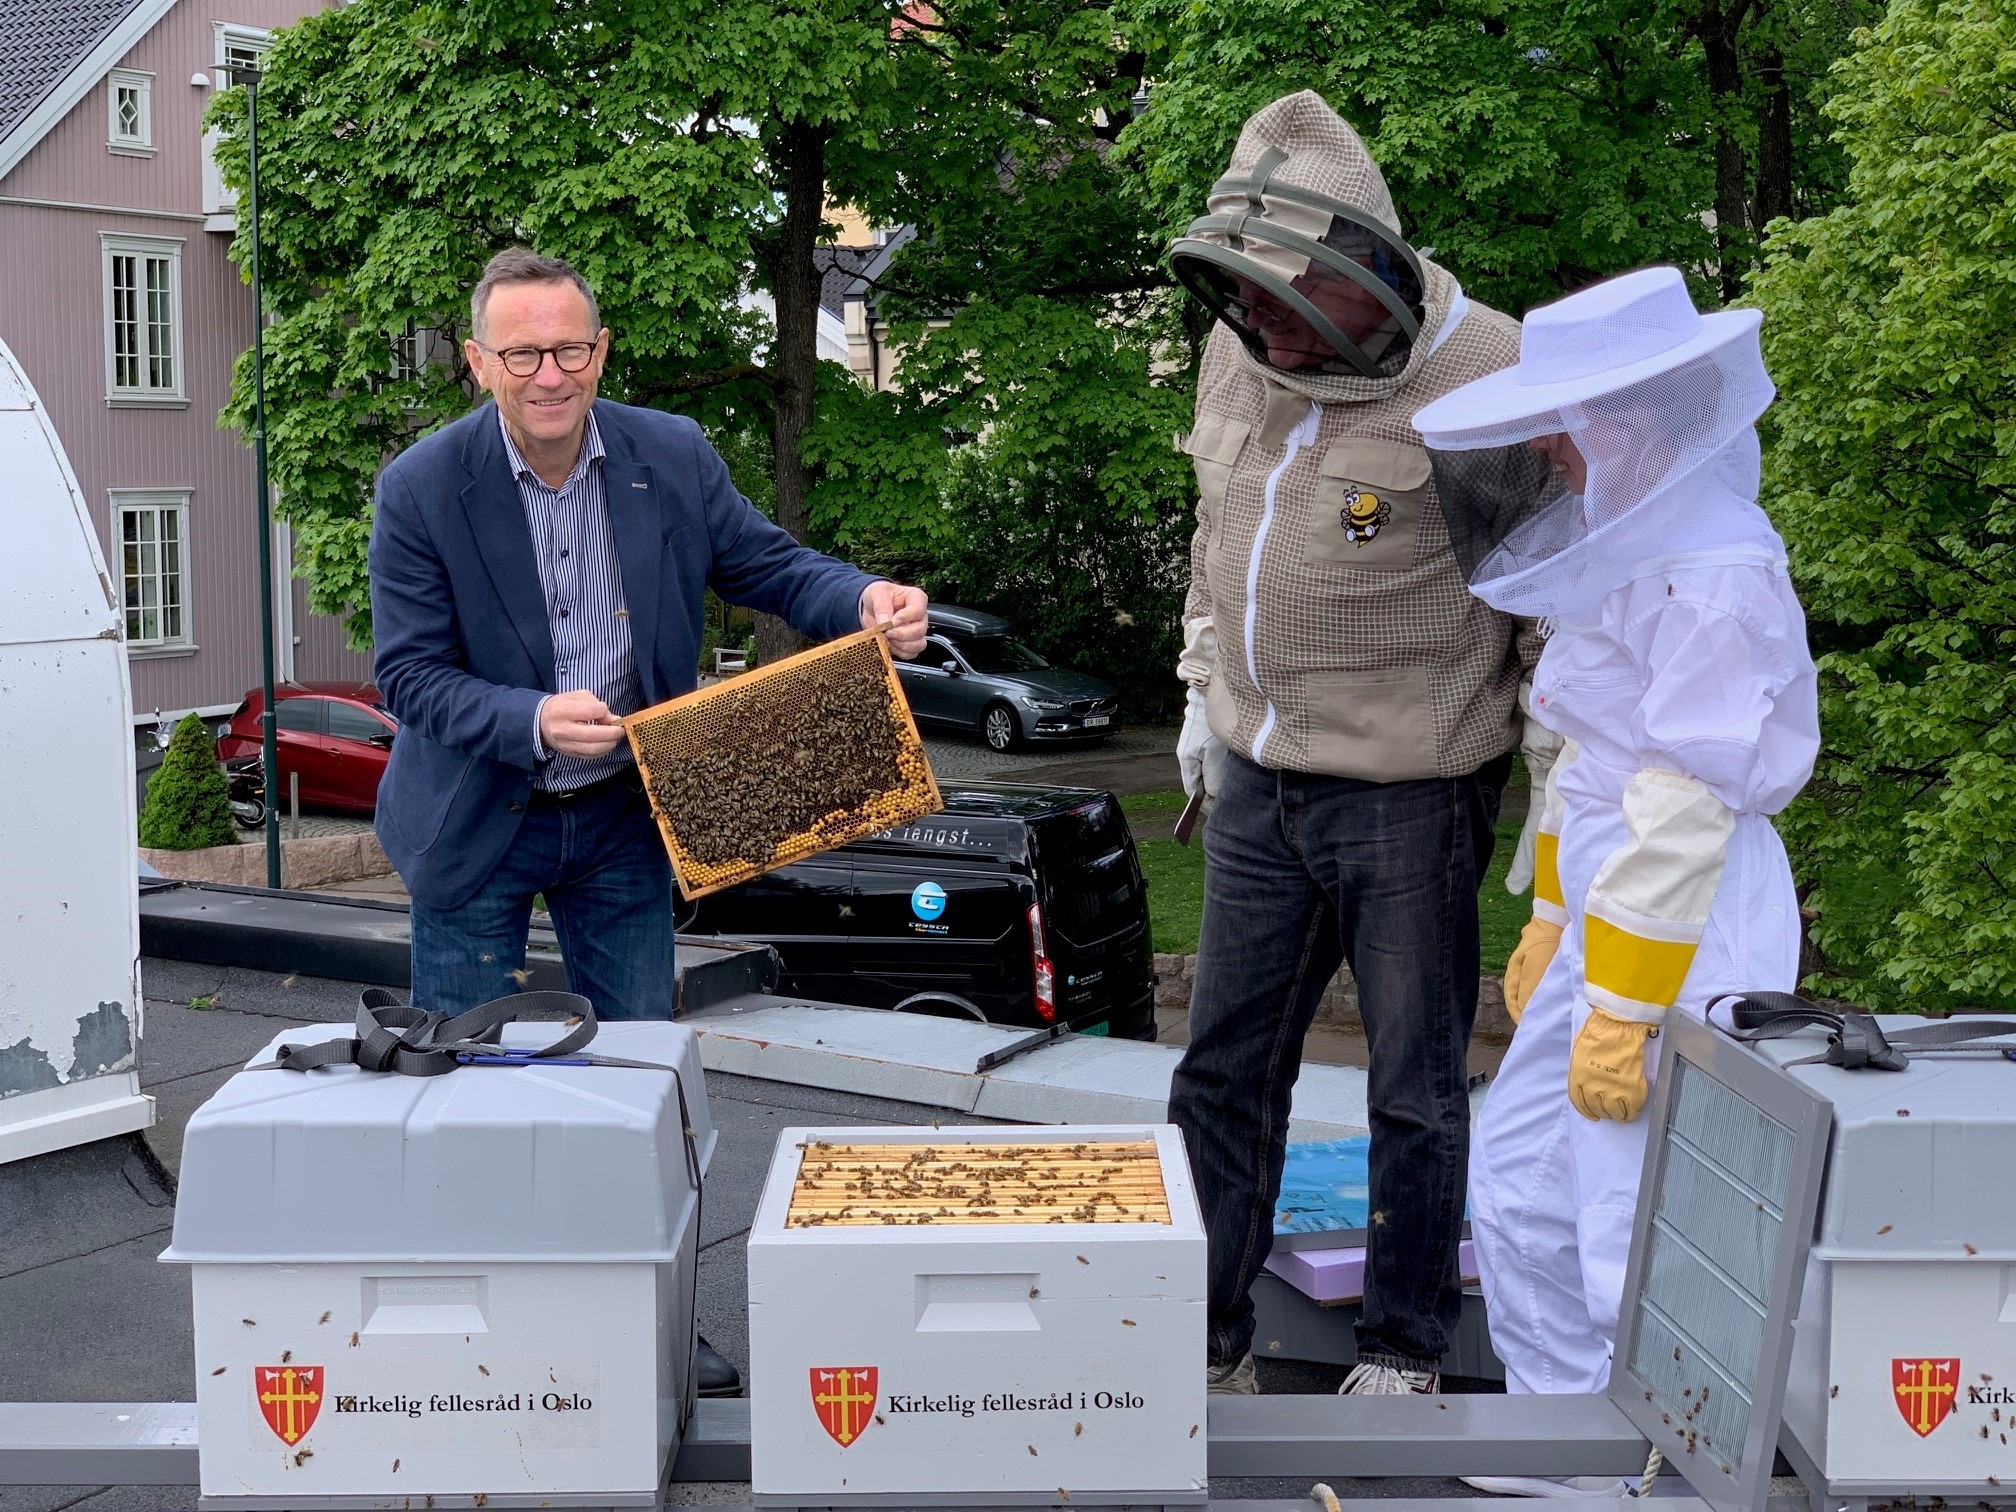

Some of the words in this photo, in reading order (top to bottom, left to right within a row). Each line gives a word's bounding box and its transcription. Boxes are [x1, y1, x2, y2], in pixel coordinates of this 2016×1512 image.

[334, 1394, 422, 1419] Kirkelig
[429, 1392, 521, 1412] fellesråd
[527, 1393, 535, 1411] i
[541, 1392, 592, 1413] Oslo
[888, 1394, 976, 1418] Kirkelig
[981, 1390, 1074, 1412] fellesråd
[1078, 1391, 1087, 1410] i
[1094, 1390, 1144, 1410] Oslo
[1968, 1386, 2016, 1404] Kirk
